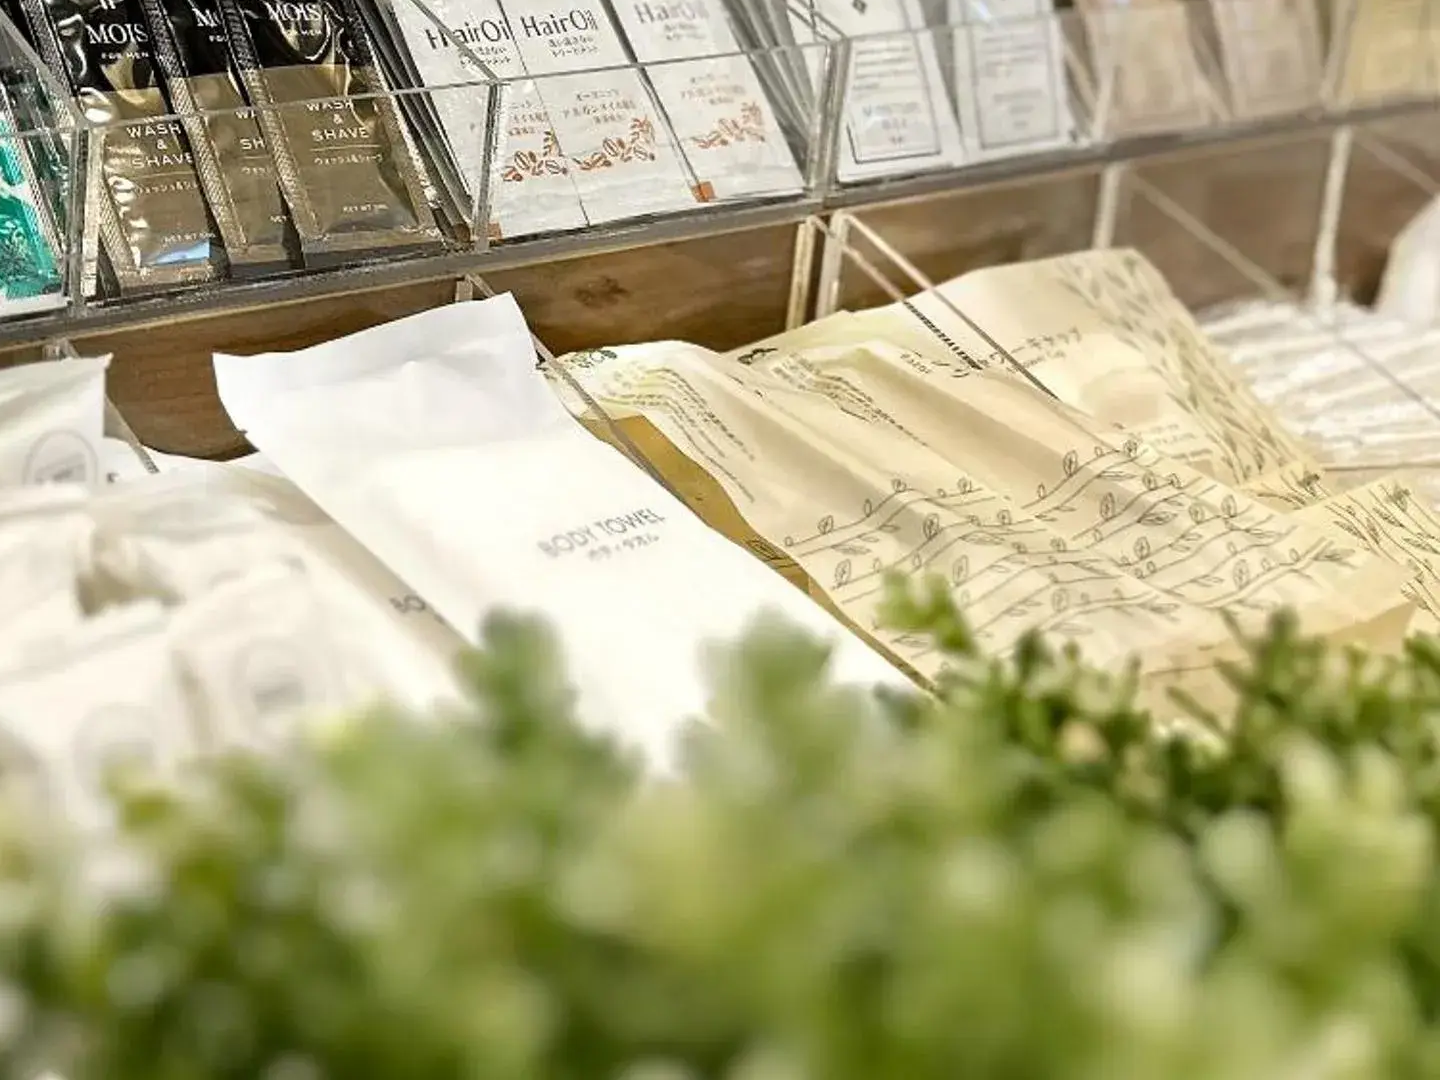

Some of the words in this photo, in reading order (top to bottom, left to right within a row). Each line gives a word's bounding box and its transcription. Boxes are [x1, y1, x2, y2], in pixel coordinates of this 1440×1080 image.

[85, 23, 149, 45] MOIS
[425, 19, 510, 50] HairOi
[332, 113, 344, 125] &
[126, 122, 182, 138] WASH
[311, 127, 371, 142] SHAVE
[156, 138, 168, 151] &
[131, 152, 194, 170] SHAVE
